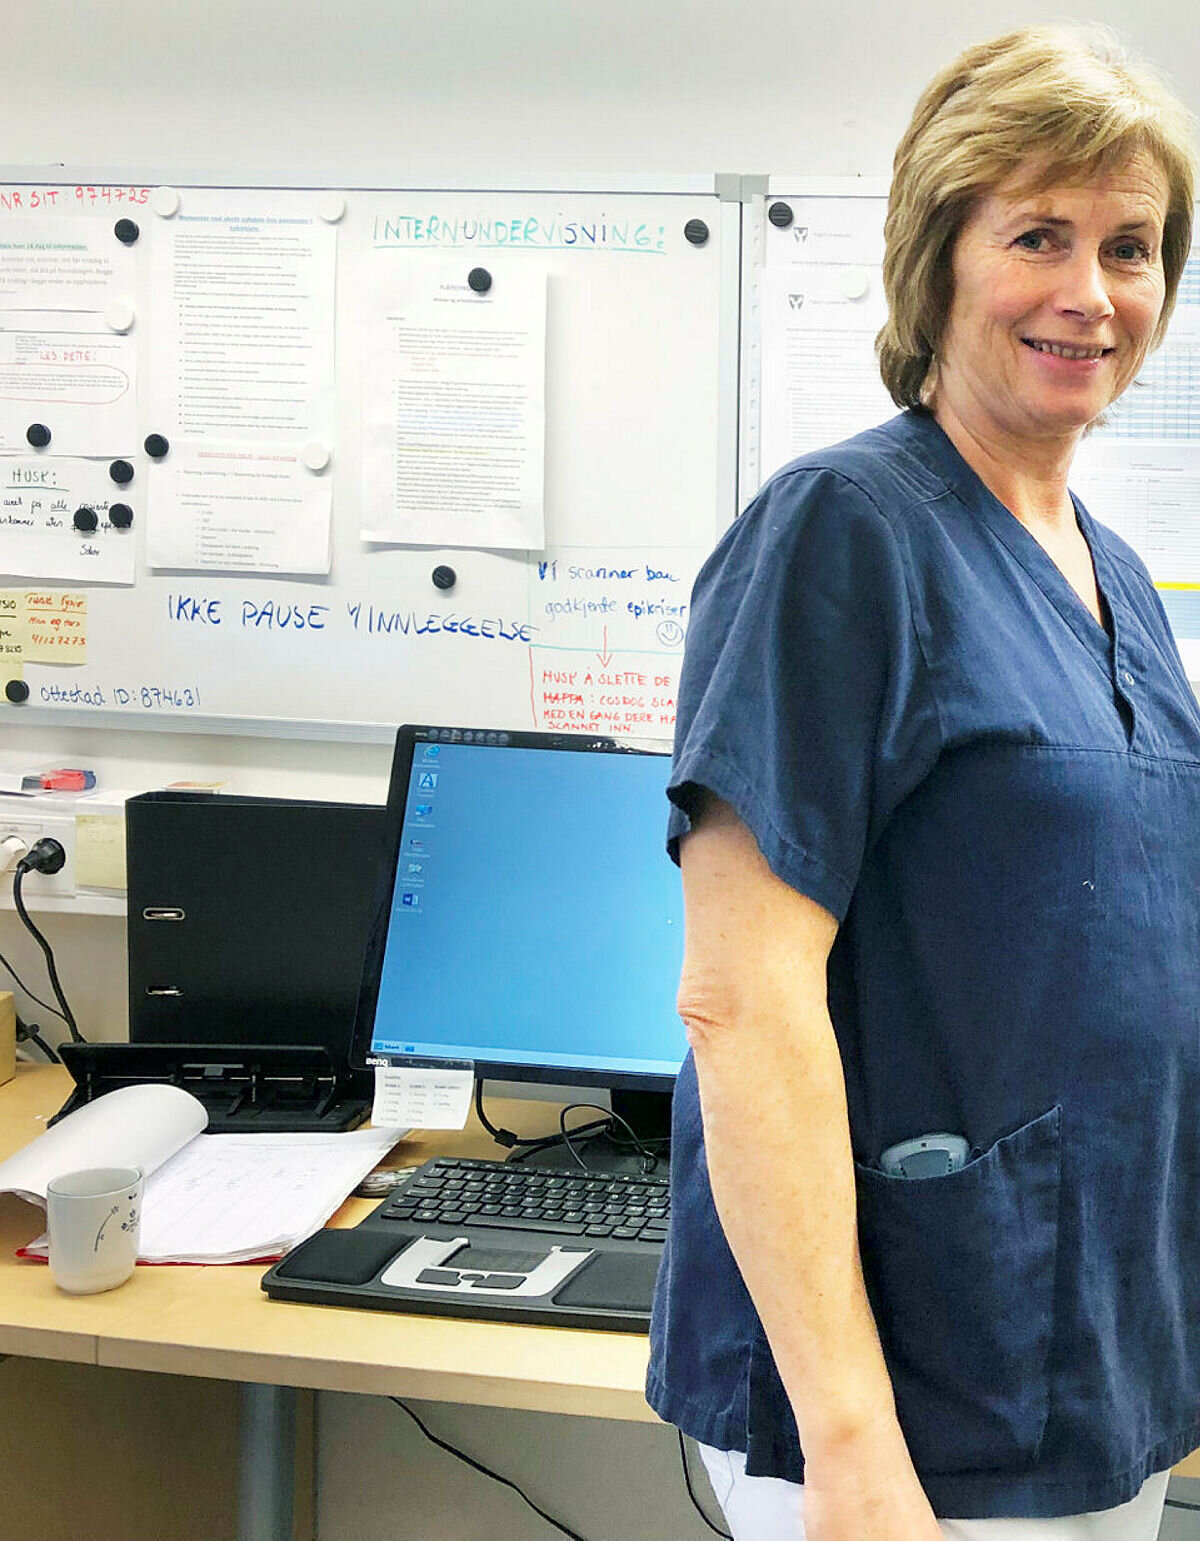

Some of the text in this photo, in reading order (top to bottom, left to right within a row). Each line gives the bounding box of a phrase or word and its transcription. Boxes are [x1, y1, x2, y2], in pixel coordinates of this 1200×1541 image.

[168, 594, 222, 625] IKKE
[241, 599, 331, 629] PAUSE
[654, 676, 671, 687] DE
